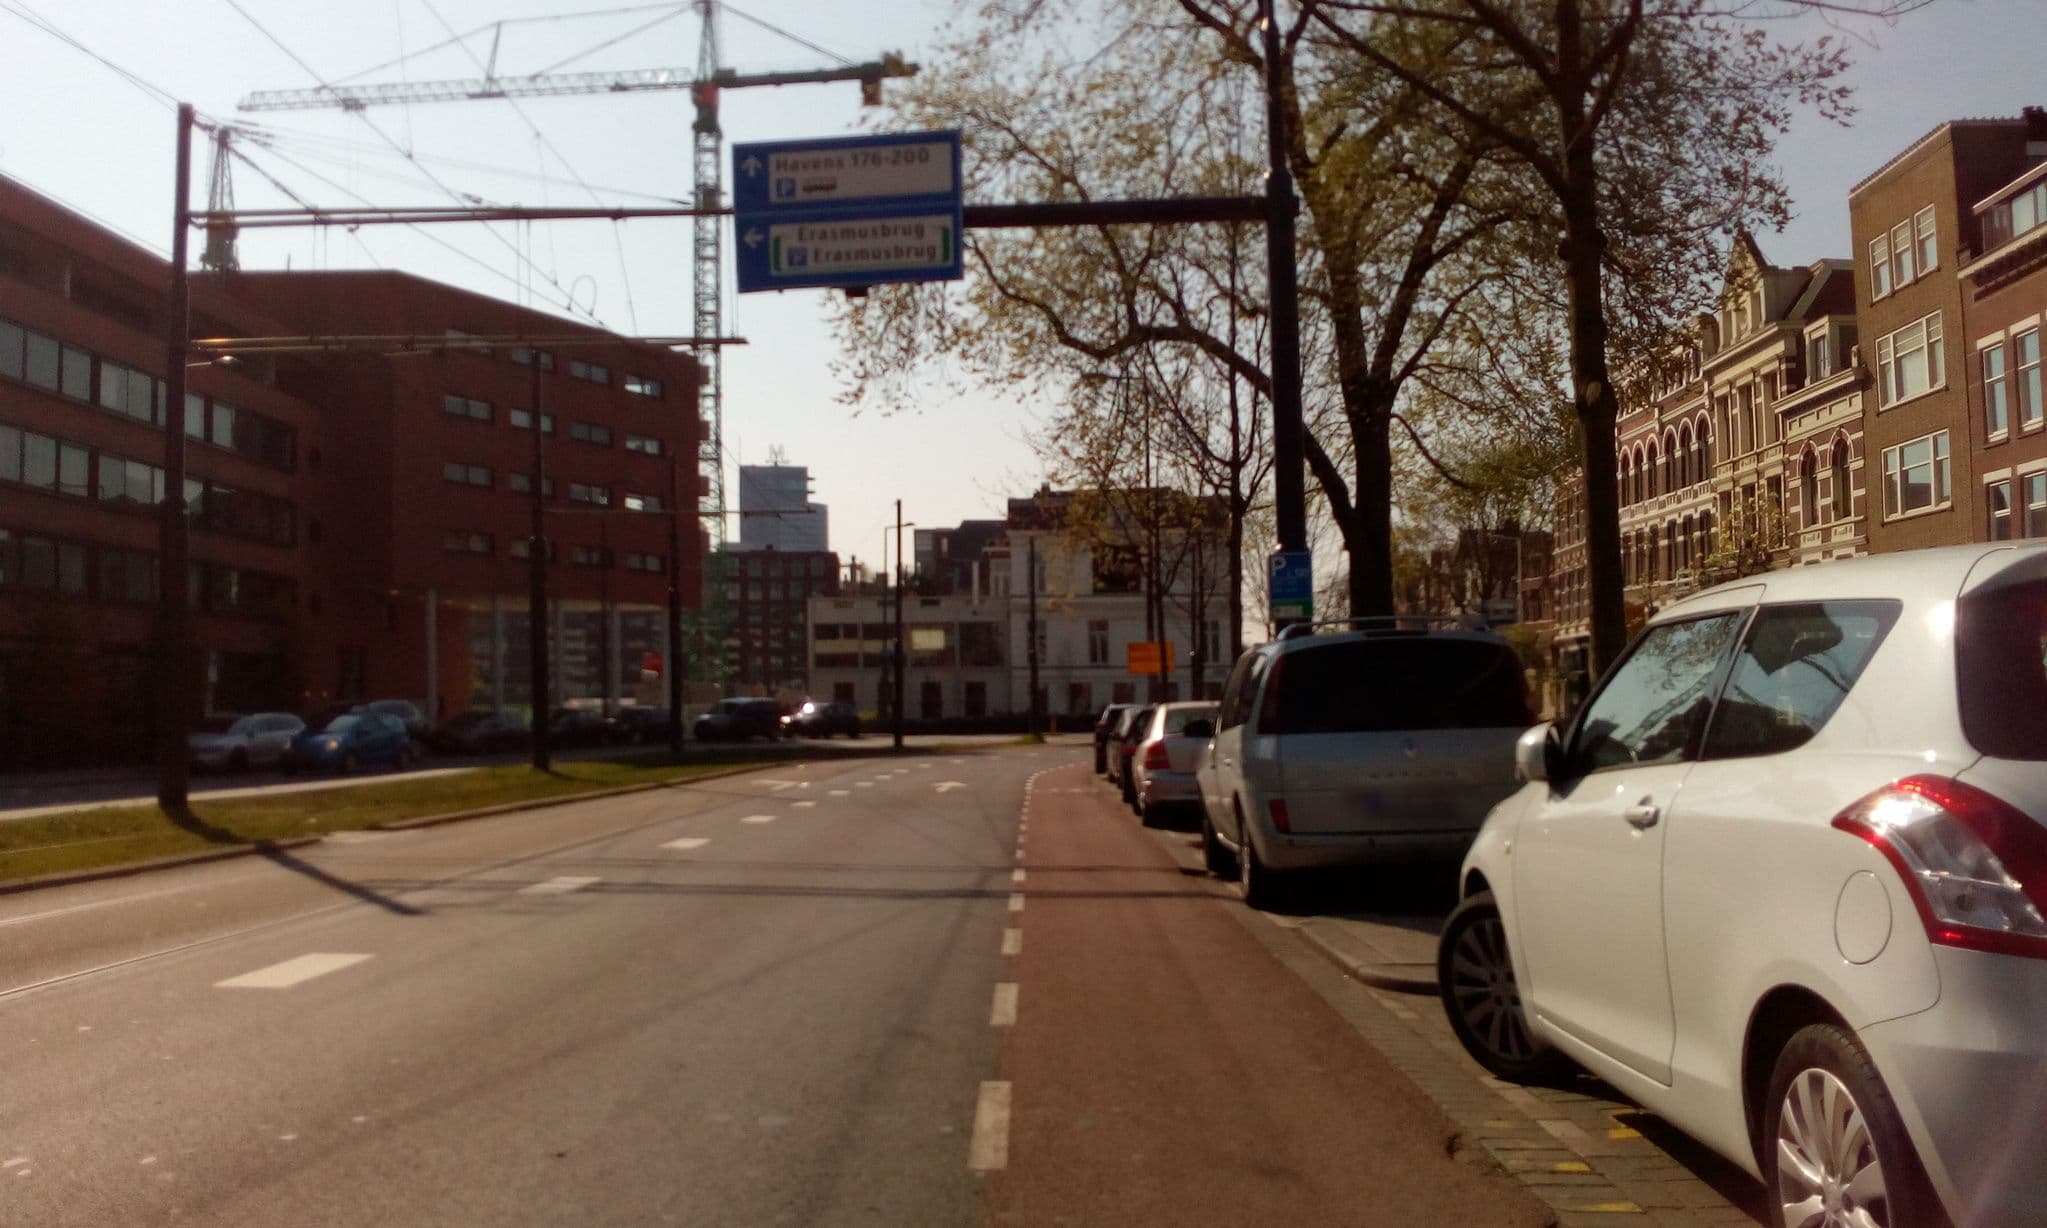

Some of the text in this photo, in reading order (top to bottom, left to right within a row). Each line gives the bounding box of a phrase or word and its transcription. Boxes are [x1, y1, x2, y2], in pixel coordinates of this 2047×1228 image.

[775, 149, 930, 172] Havens 176-200
[798, 222, 925, 241] Erasmusbrug
[813, 244, 937, 263] Erasmusbrug
[1271, 555, 1287, 577] P
